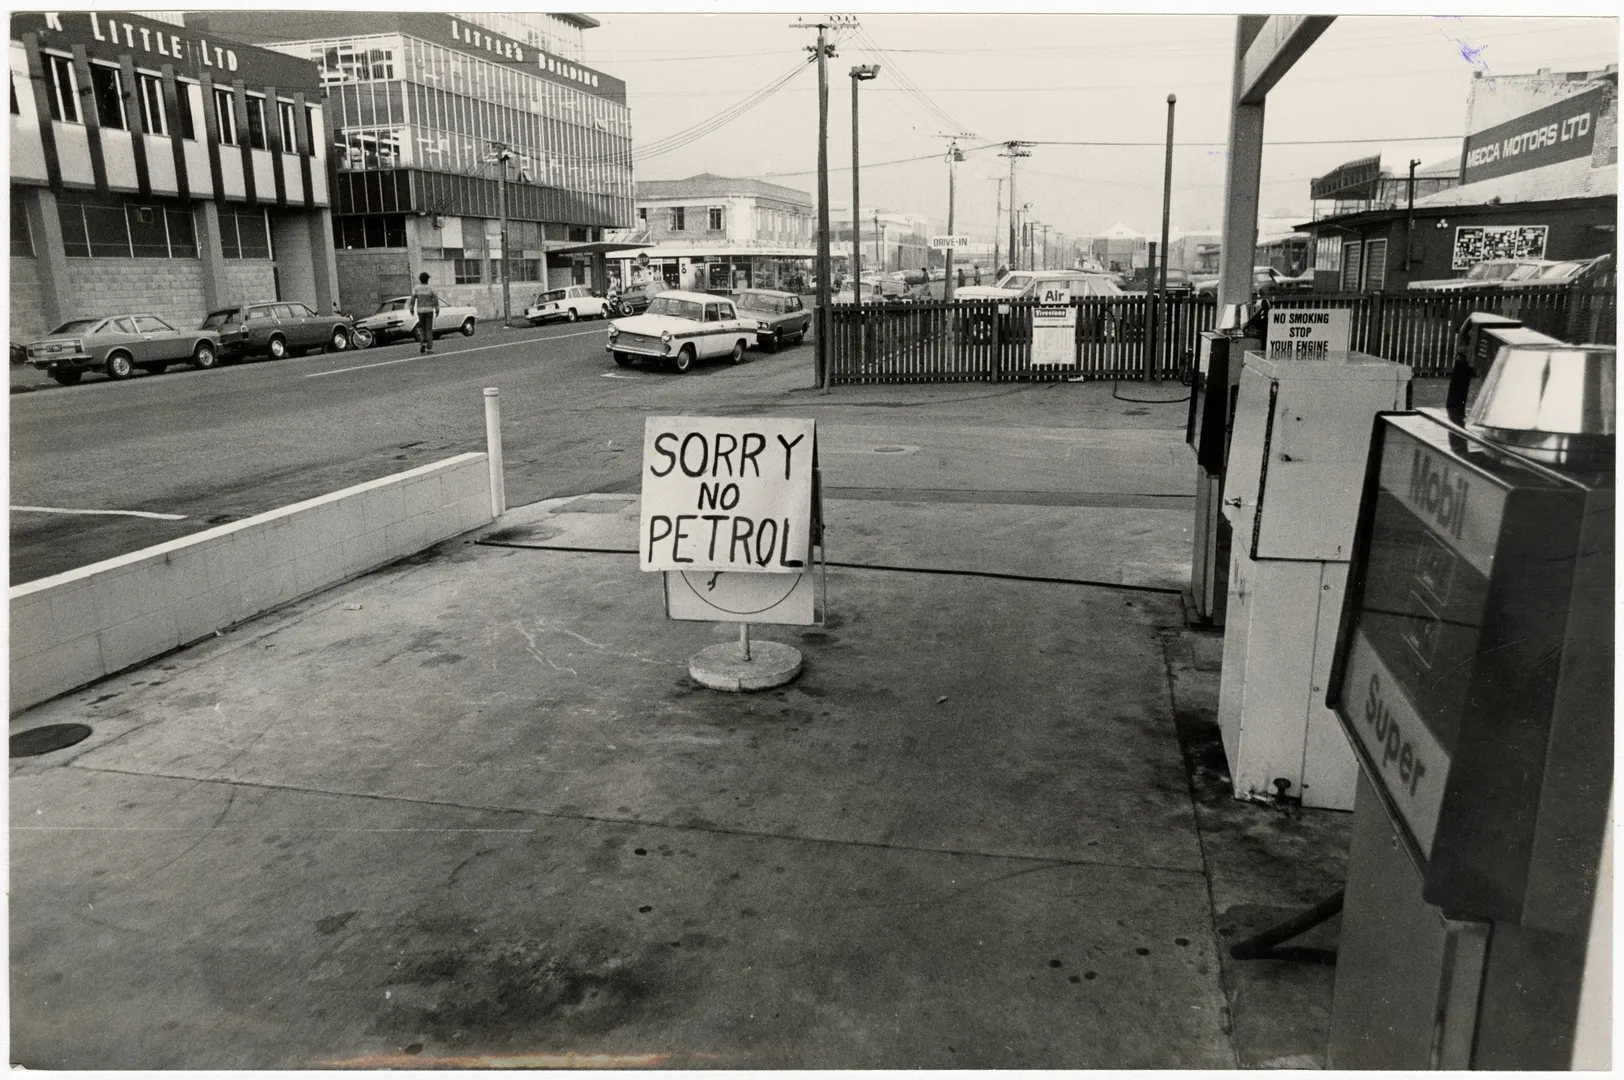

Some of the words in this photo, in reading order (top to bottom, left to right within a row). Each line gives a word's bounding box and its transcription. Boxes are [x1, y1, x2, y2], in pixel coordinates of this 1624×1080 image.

[90, 12, 183, 59] LITTLE
[201, 40, 238, 71] LTD
[538, 53, 599, 88] BUILDING
[1466, 142, 1500, 168] MECCA
[1502, 123, 1558, 157] MOTORS
[1561, 112, 1591, 142] LTD
[933, 238, 968, 247] DRIVE-IN
[1045, 290, 1065, 302] Air
[1273, 313, 1286, 324] NO
[1289, 313, 1330, 324] SMOKING
[1289, 327, 1312, 338] STOP
[1270, 340, 1293, 352] YOUR
[1296, 340, 1329, 352] ENGINE
[650, 432, 804, 480] SORRY
[697, 482, 740, 510] NO
[1407, 448, 1470, 541] Mobil
[648, 514, 804, 568] PETROL
[1365, 673, 1427, 798] Super
